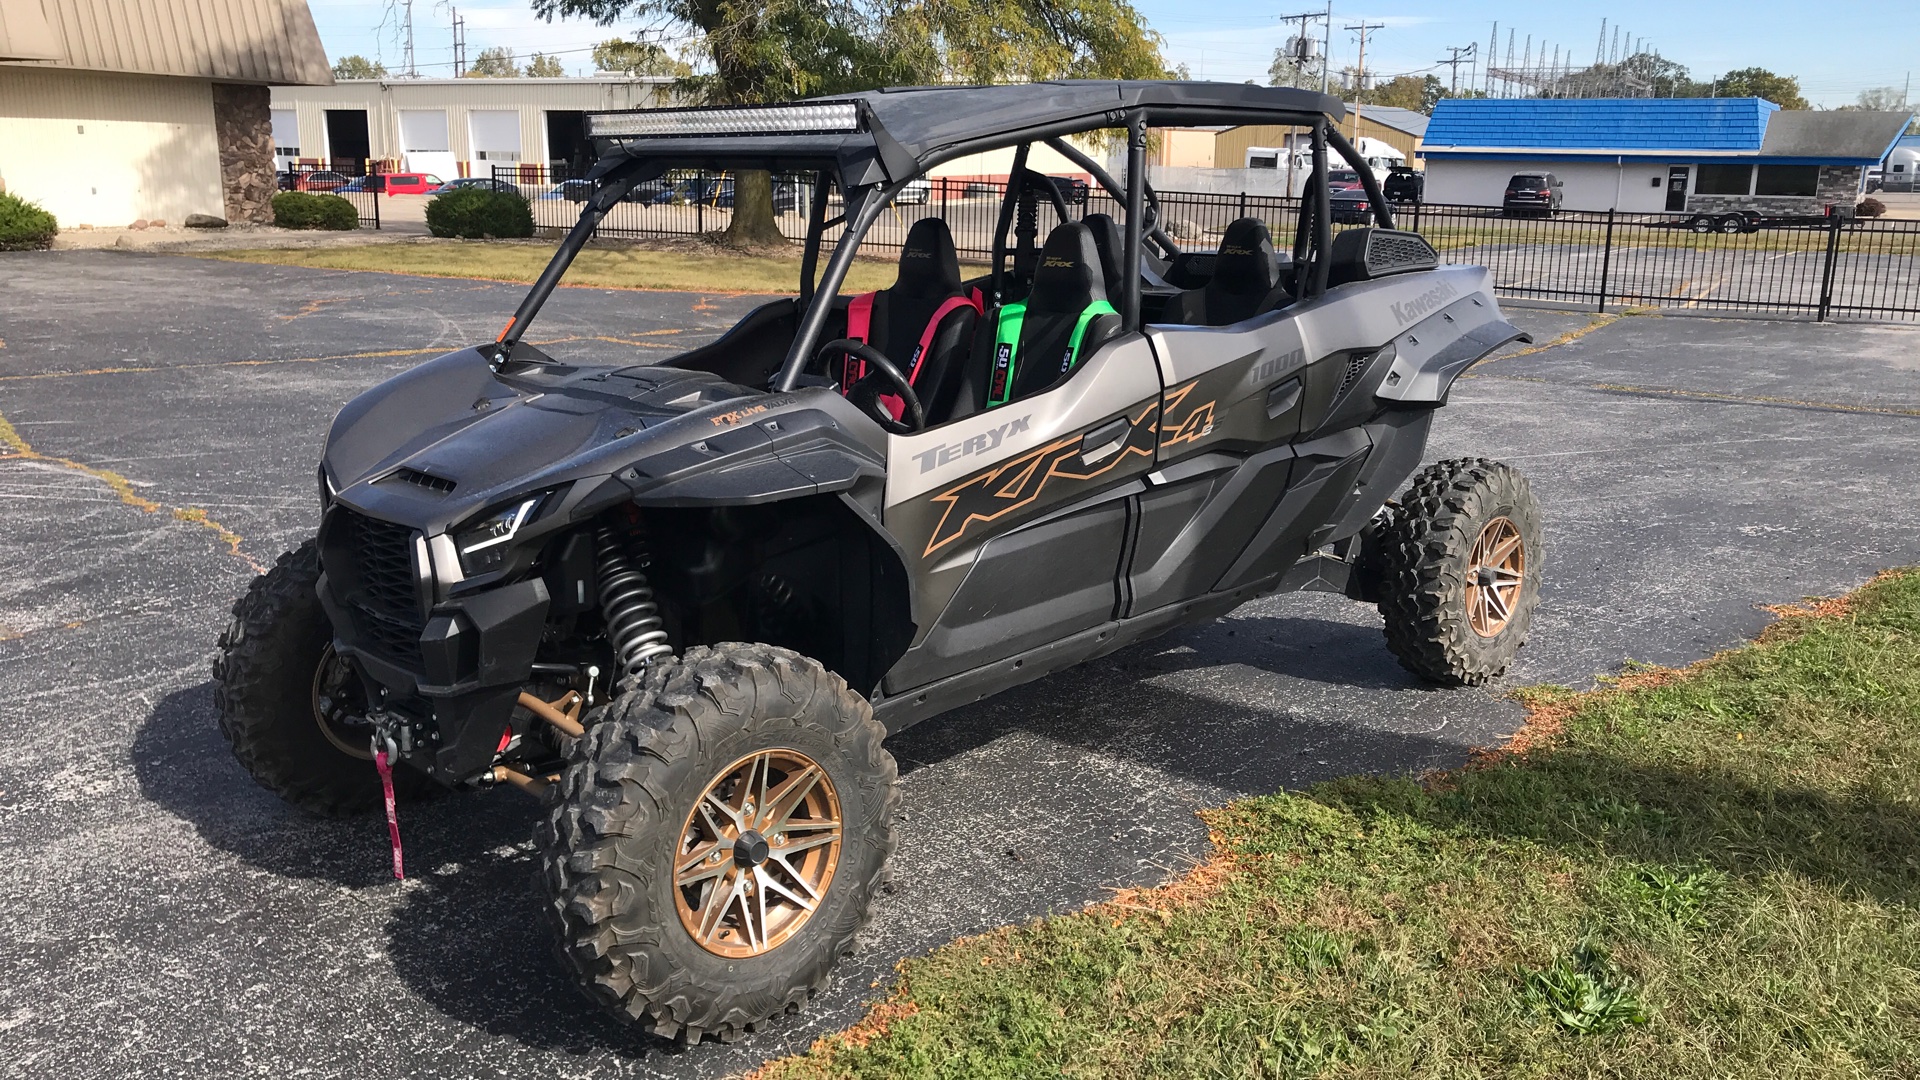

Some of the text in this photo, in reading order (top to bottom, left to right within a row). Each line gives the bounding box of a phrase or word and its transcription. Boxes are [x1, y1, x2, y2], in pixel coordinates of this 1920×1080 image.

[1390, 279, 1459, 327] Kawasaki
[1252, 348, 1304, 385] 1000
[710, 411, 742, 427] FOX
